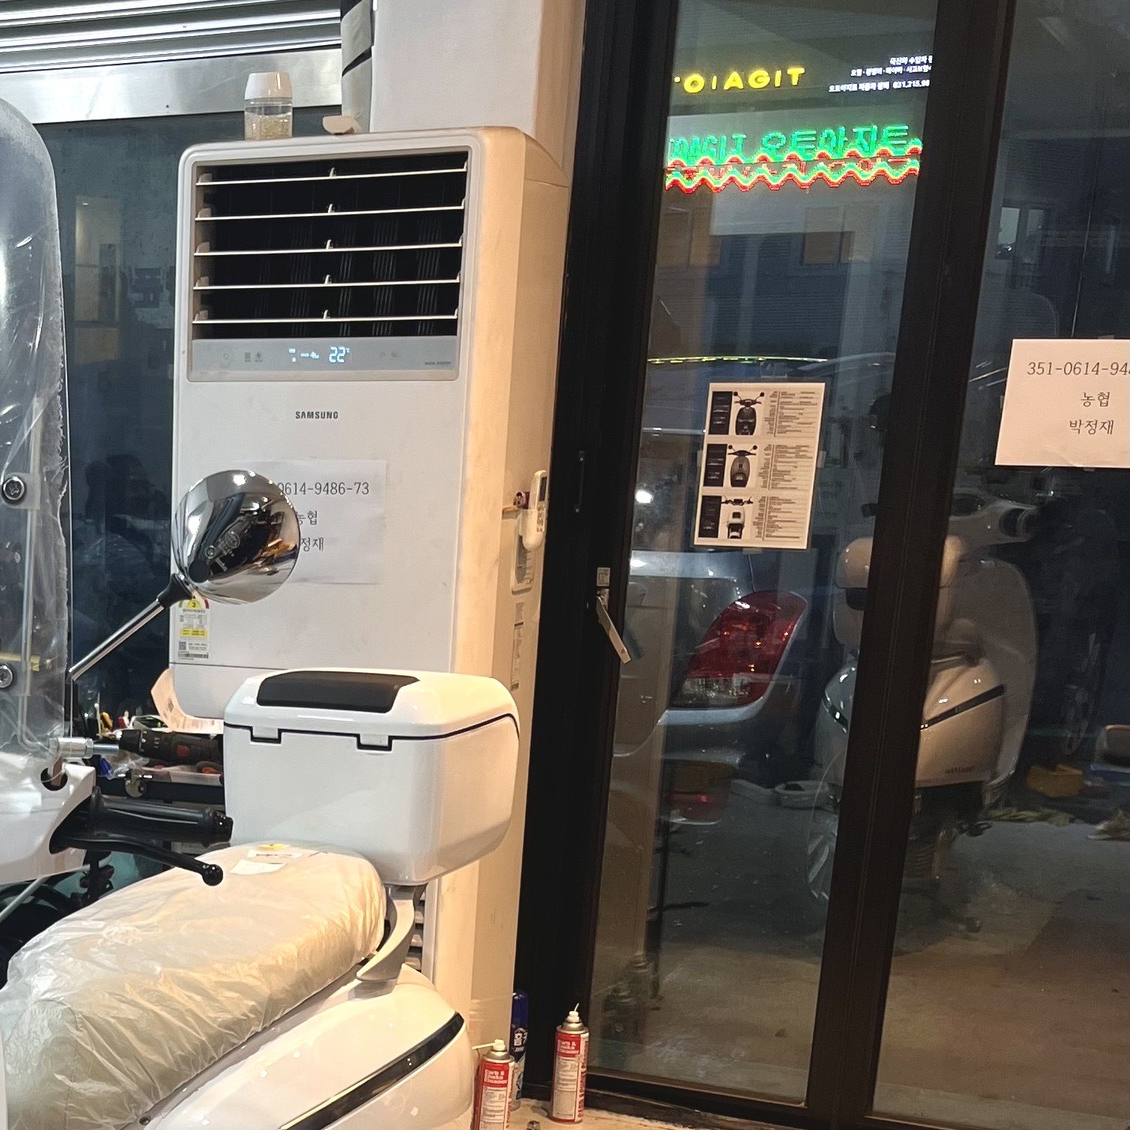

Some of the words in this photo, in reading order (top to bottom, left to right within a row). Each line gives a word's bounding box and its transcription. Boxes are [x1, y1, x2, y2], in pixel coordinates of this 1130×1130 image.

[1026, 361, 1130, 376] 351-0614-94
[1080, 391, 1110, 408] 농협
[295, 410, 339, 420] SAMSUNG
[1069, 419, 1114, 435] 박정재
